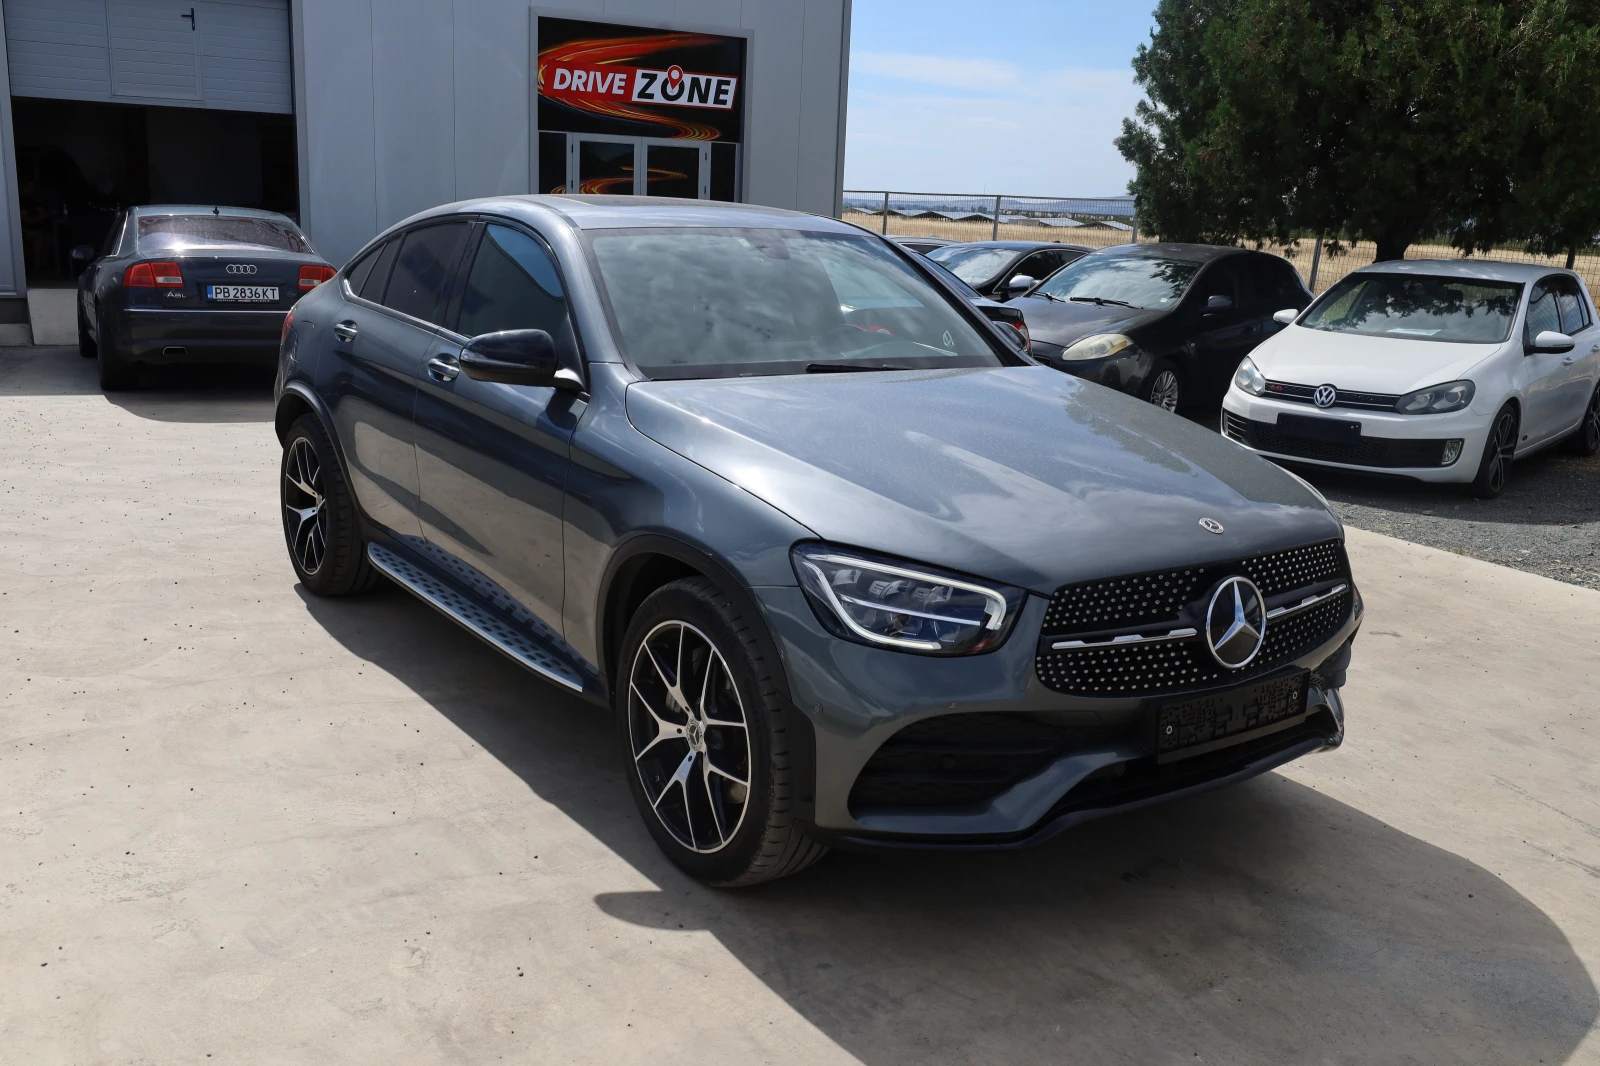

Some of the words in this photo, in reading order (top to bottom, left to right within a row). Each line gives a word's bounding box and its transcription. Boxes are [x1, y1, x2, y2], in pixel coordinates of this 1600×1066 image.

[553, 68, 627, 95] DRIVE
[637, 72, 731, 105] ZONE
[215, 287, 230, 298] PB
[233, 287, 260, 299] 2836
[262, 288, 277, 299] KT
